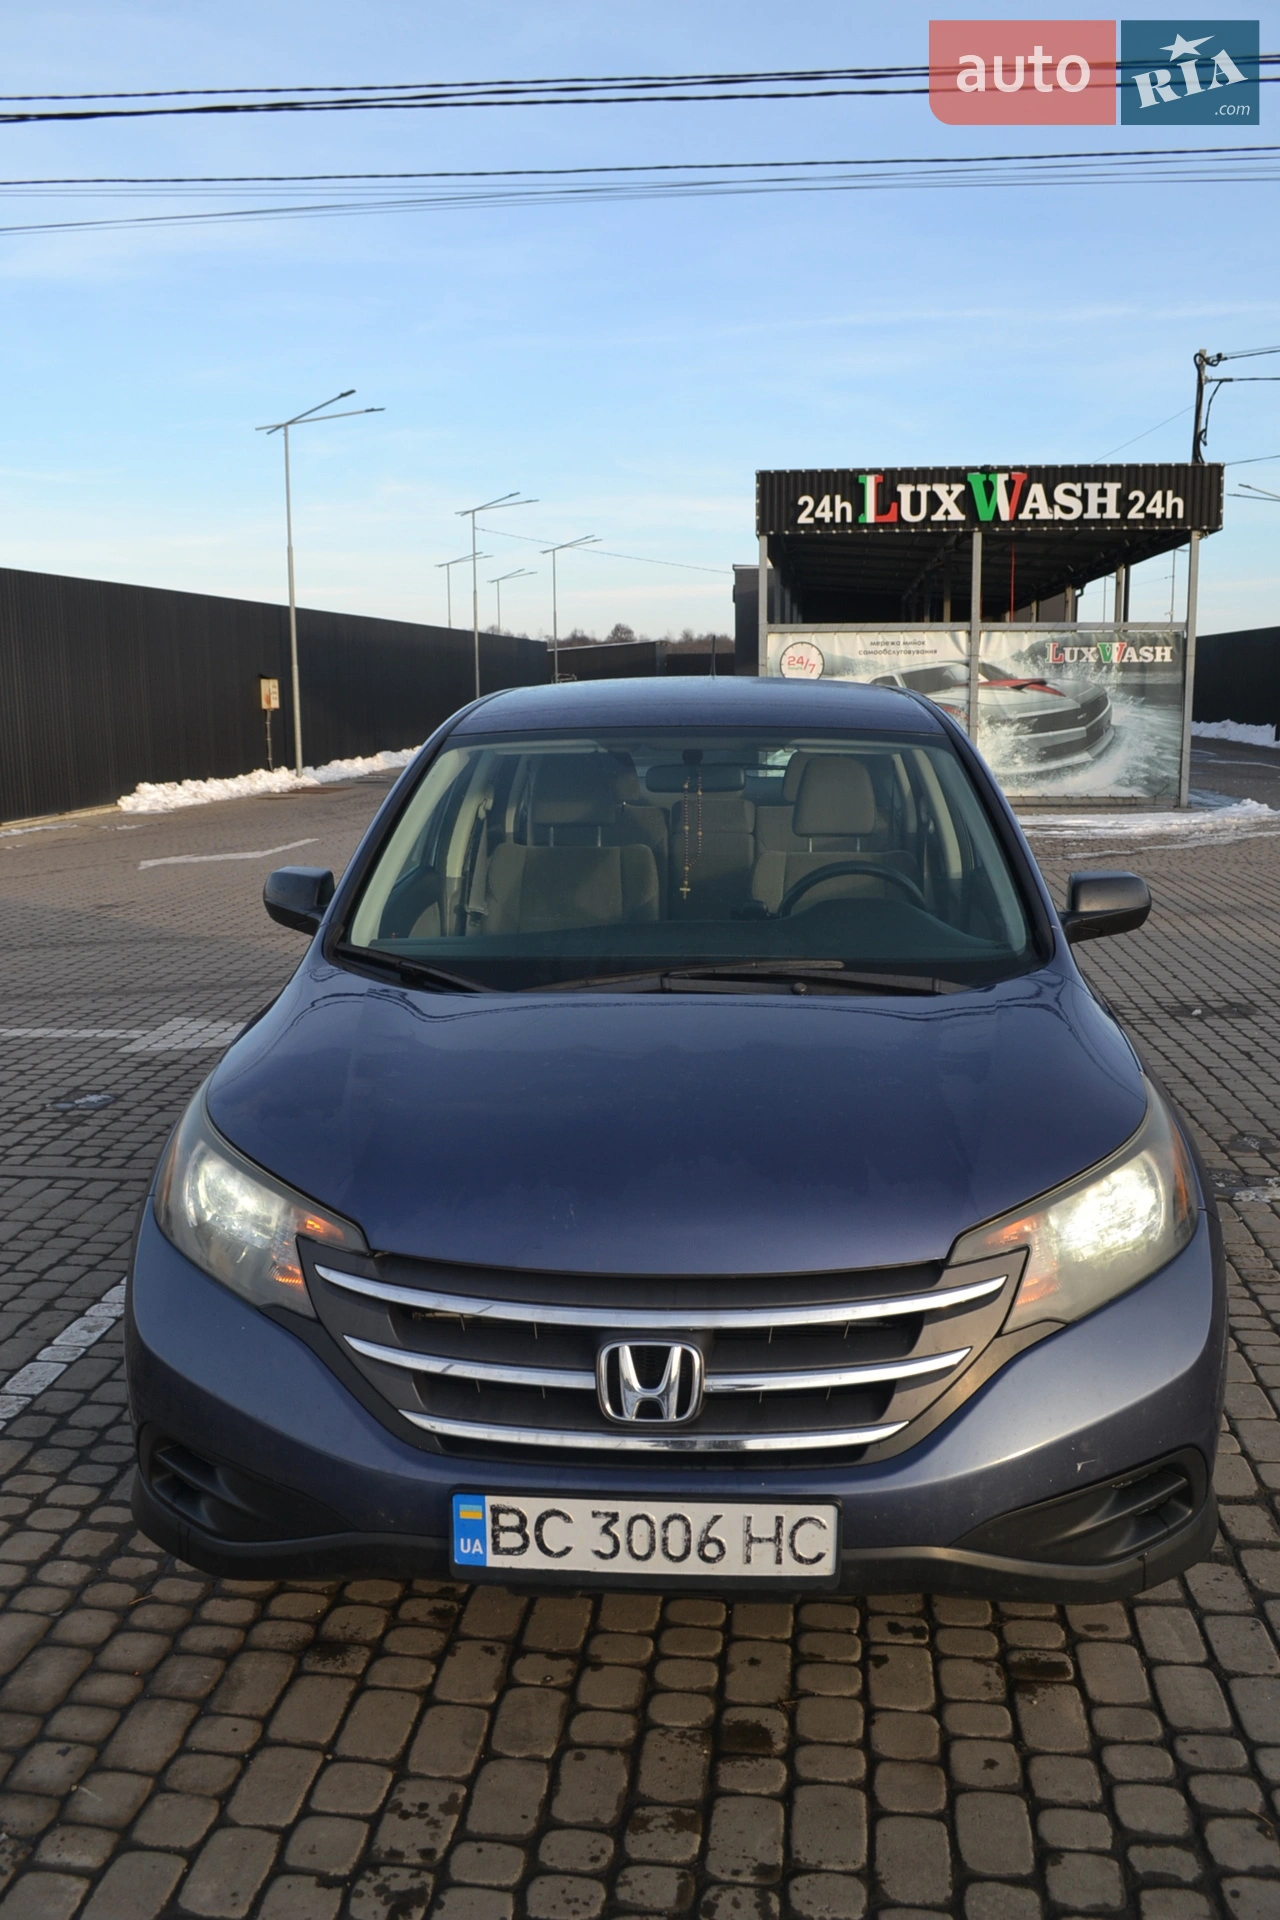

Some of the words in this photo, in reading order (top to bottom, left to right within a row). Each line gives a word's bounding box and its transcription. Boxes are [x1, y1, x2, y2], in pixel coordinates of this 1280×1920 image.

[797, 494, 852, 524] 24h
[1127, 489, 1184, 520] 24h
[787, 655, 816, 674] 24/7
[460, 1538, 484, 1555] UA
[489, 1502, 574, 1558] BC
[591, 1510, 727, 1564] 3006
[743, 1514, 829, 1566] HC
